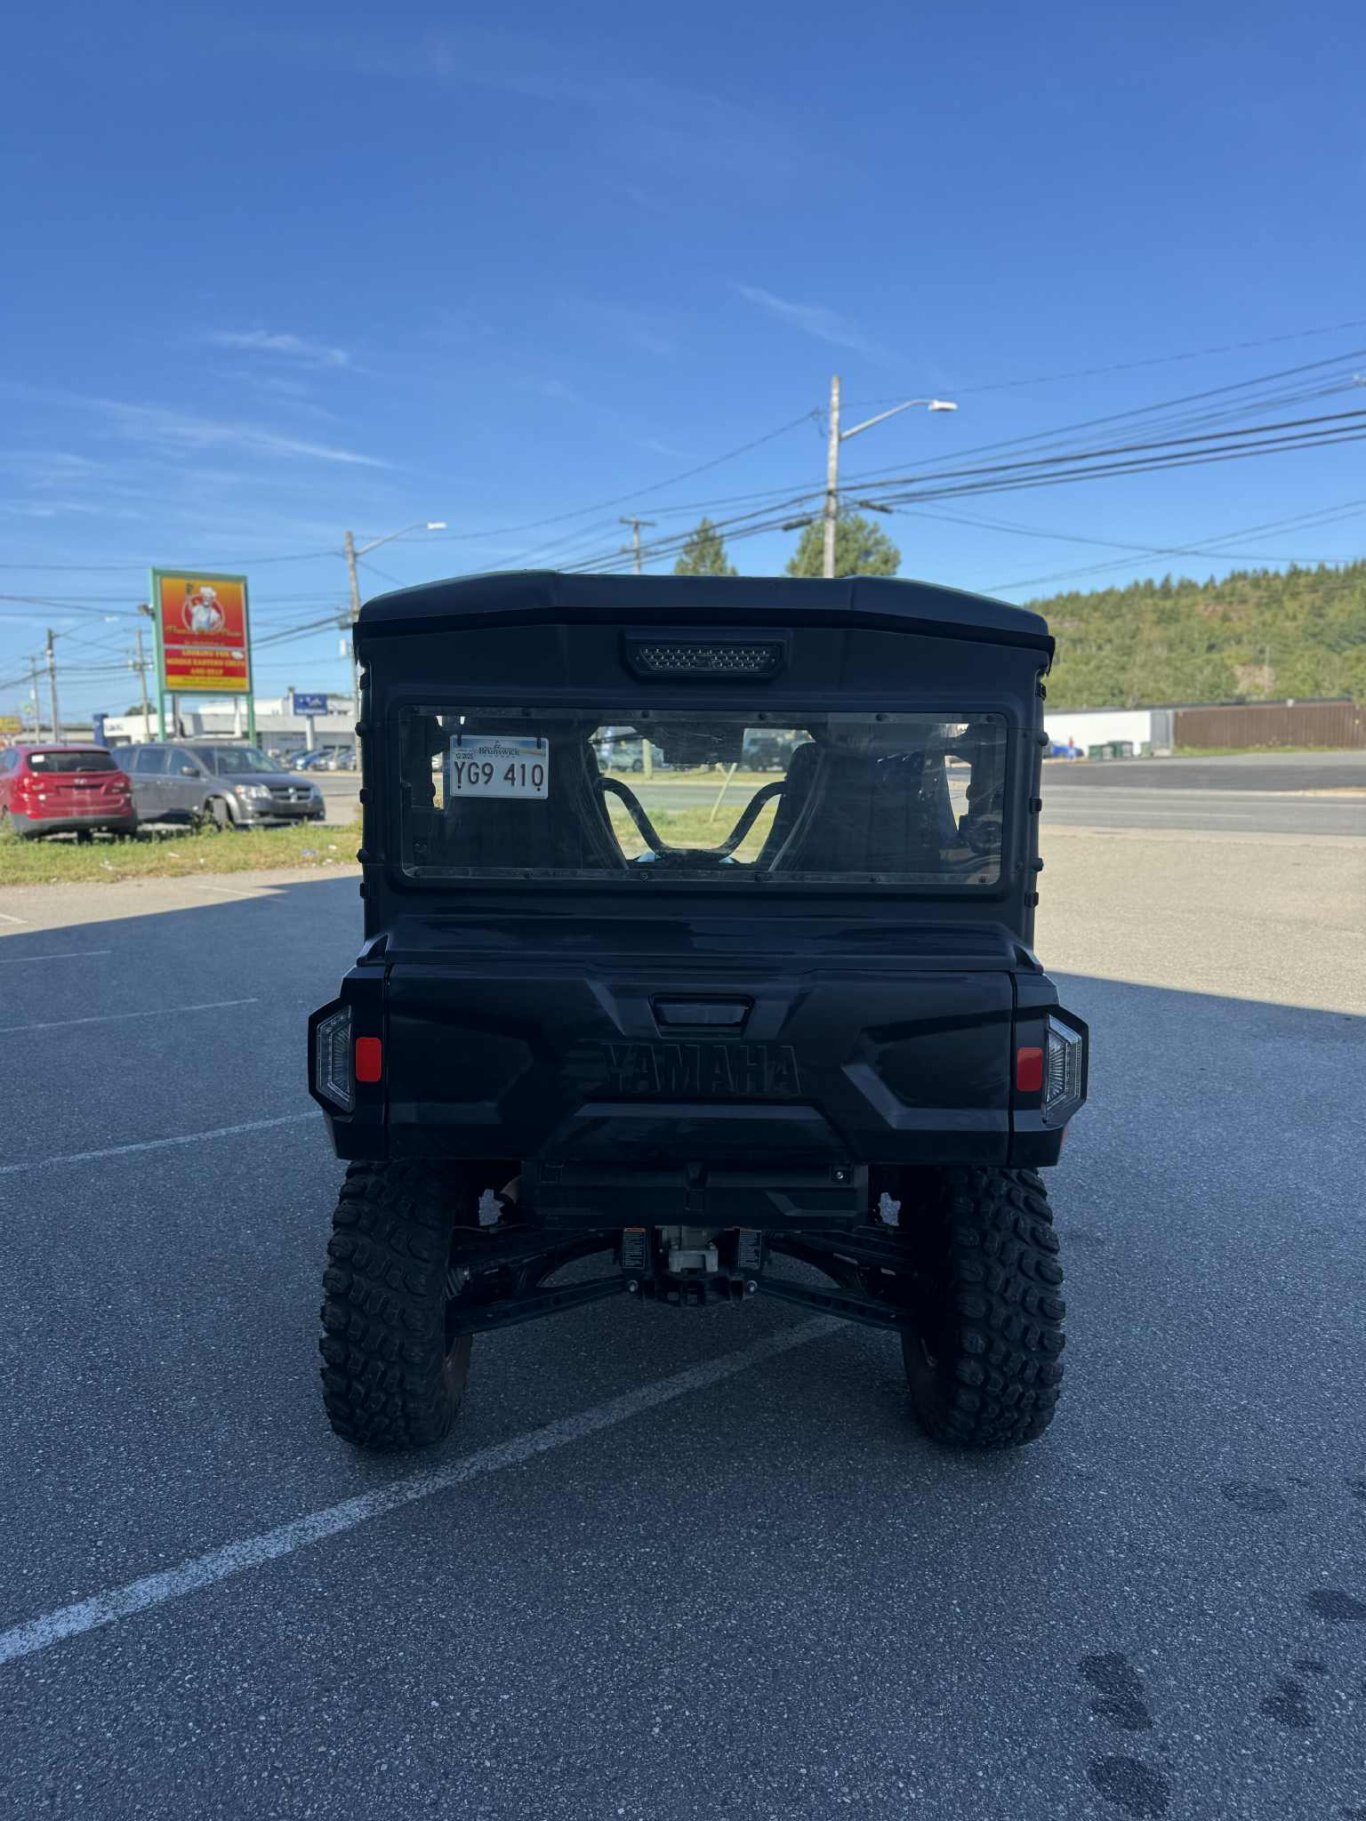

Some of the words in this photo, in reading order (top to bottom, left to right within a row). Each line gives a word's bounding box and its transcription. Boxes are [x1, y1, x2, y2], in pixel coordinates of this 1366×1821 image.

[454, 760, 494, 785] YG9
[503, 763, 544, 787] 410
[600, 1042, 801, 1094] YAMAHA
